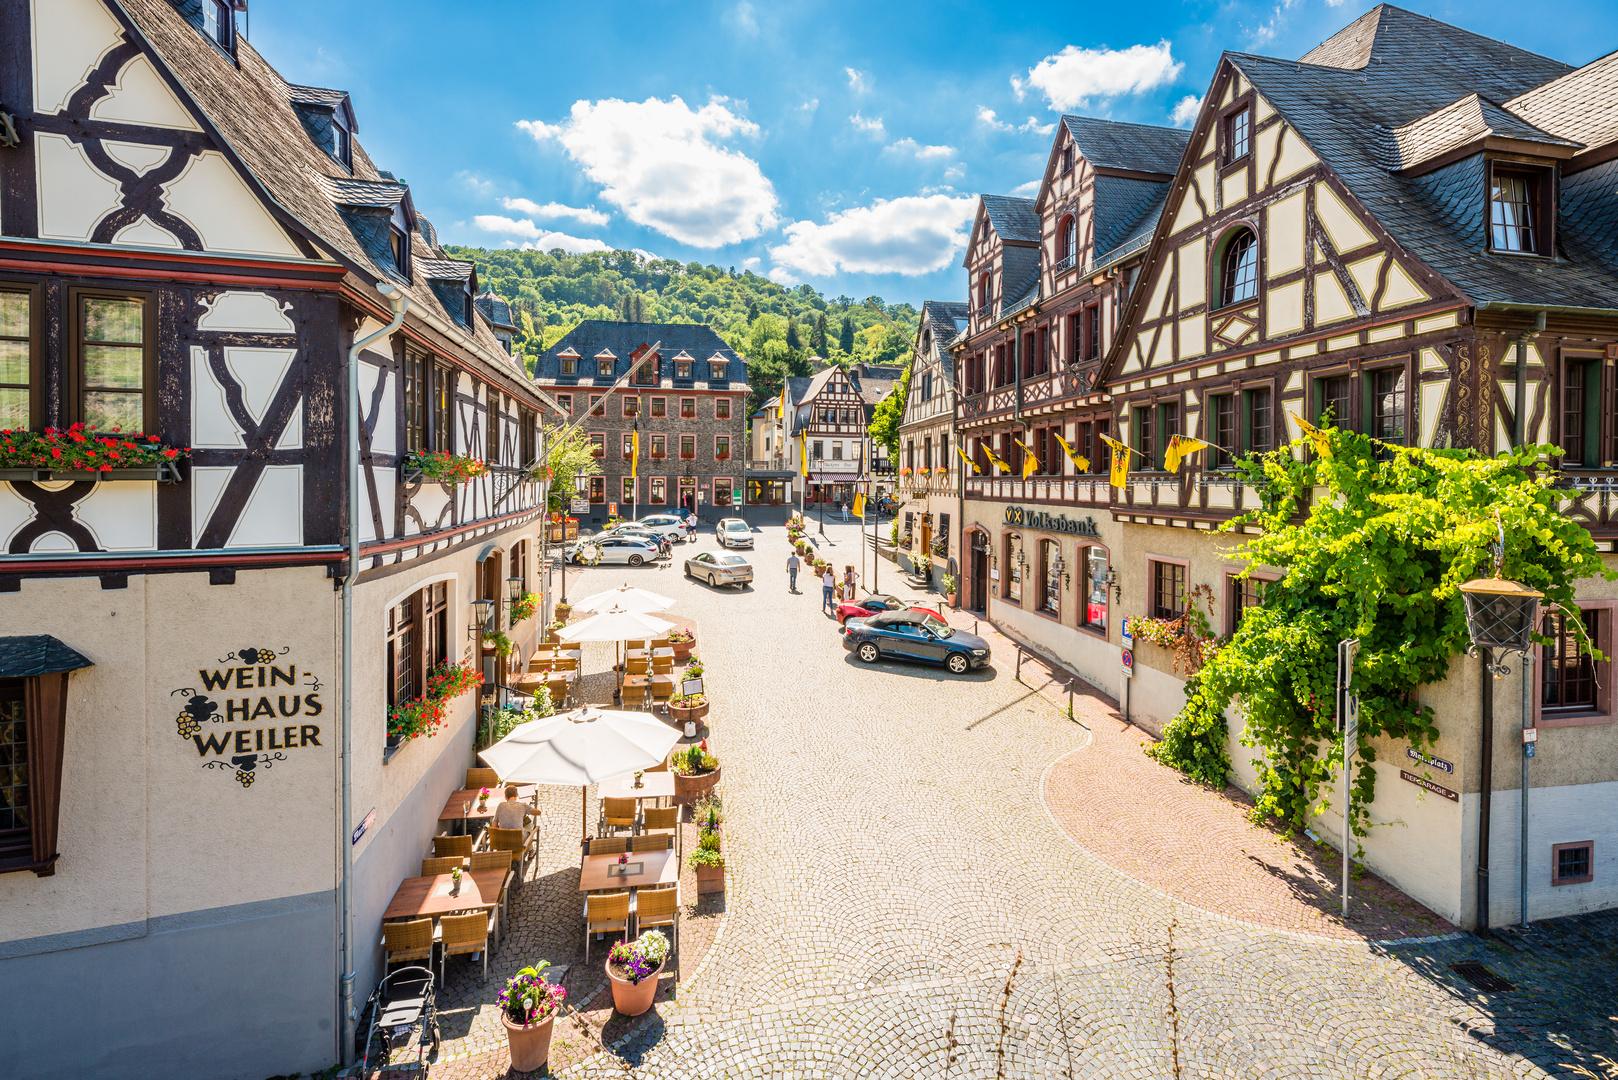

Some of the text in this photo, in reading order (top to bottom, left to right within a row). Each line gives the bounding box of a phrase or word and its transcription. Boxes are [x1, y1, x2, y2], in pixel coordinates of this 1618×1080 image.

[1024, 509, 1098, 535] Volksbank
[198, 664, 313, 692] WEIN-
[225, 693, 324, 723] HAUS
[191, 724, 324, 758] WEILER
